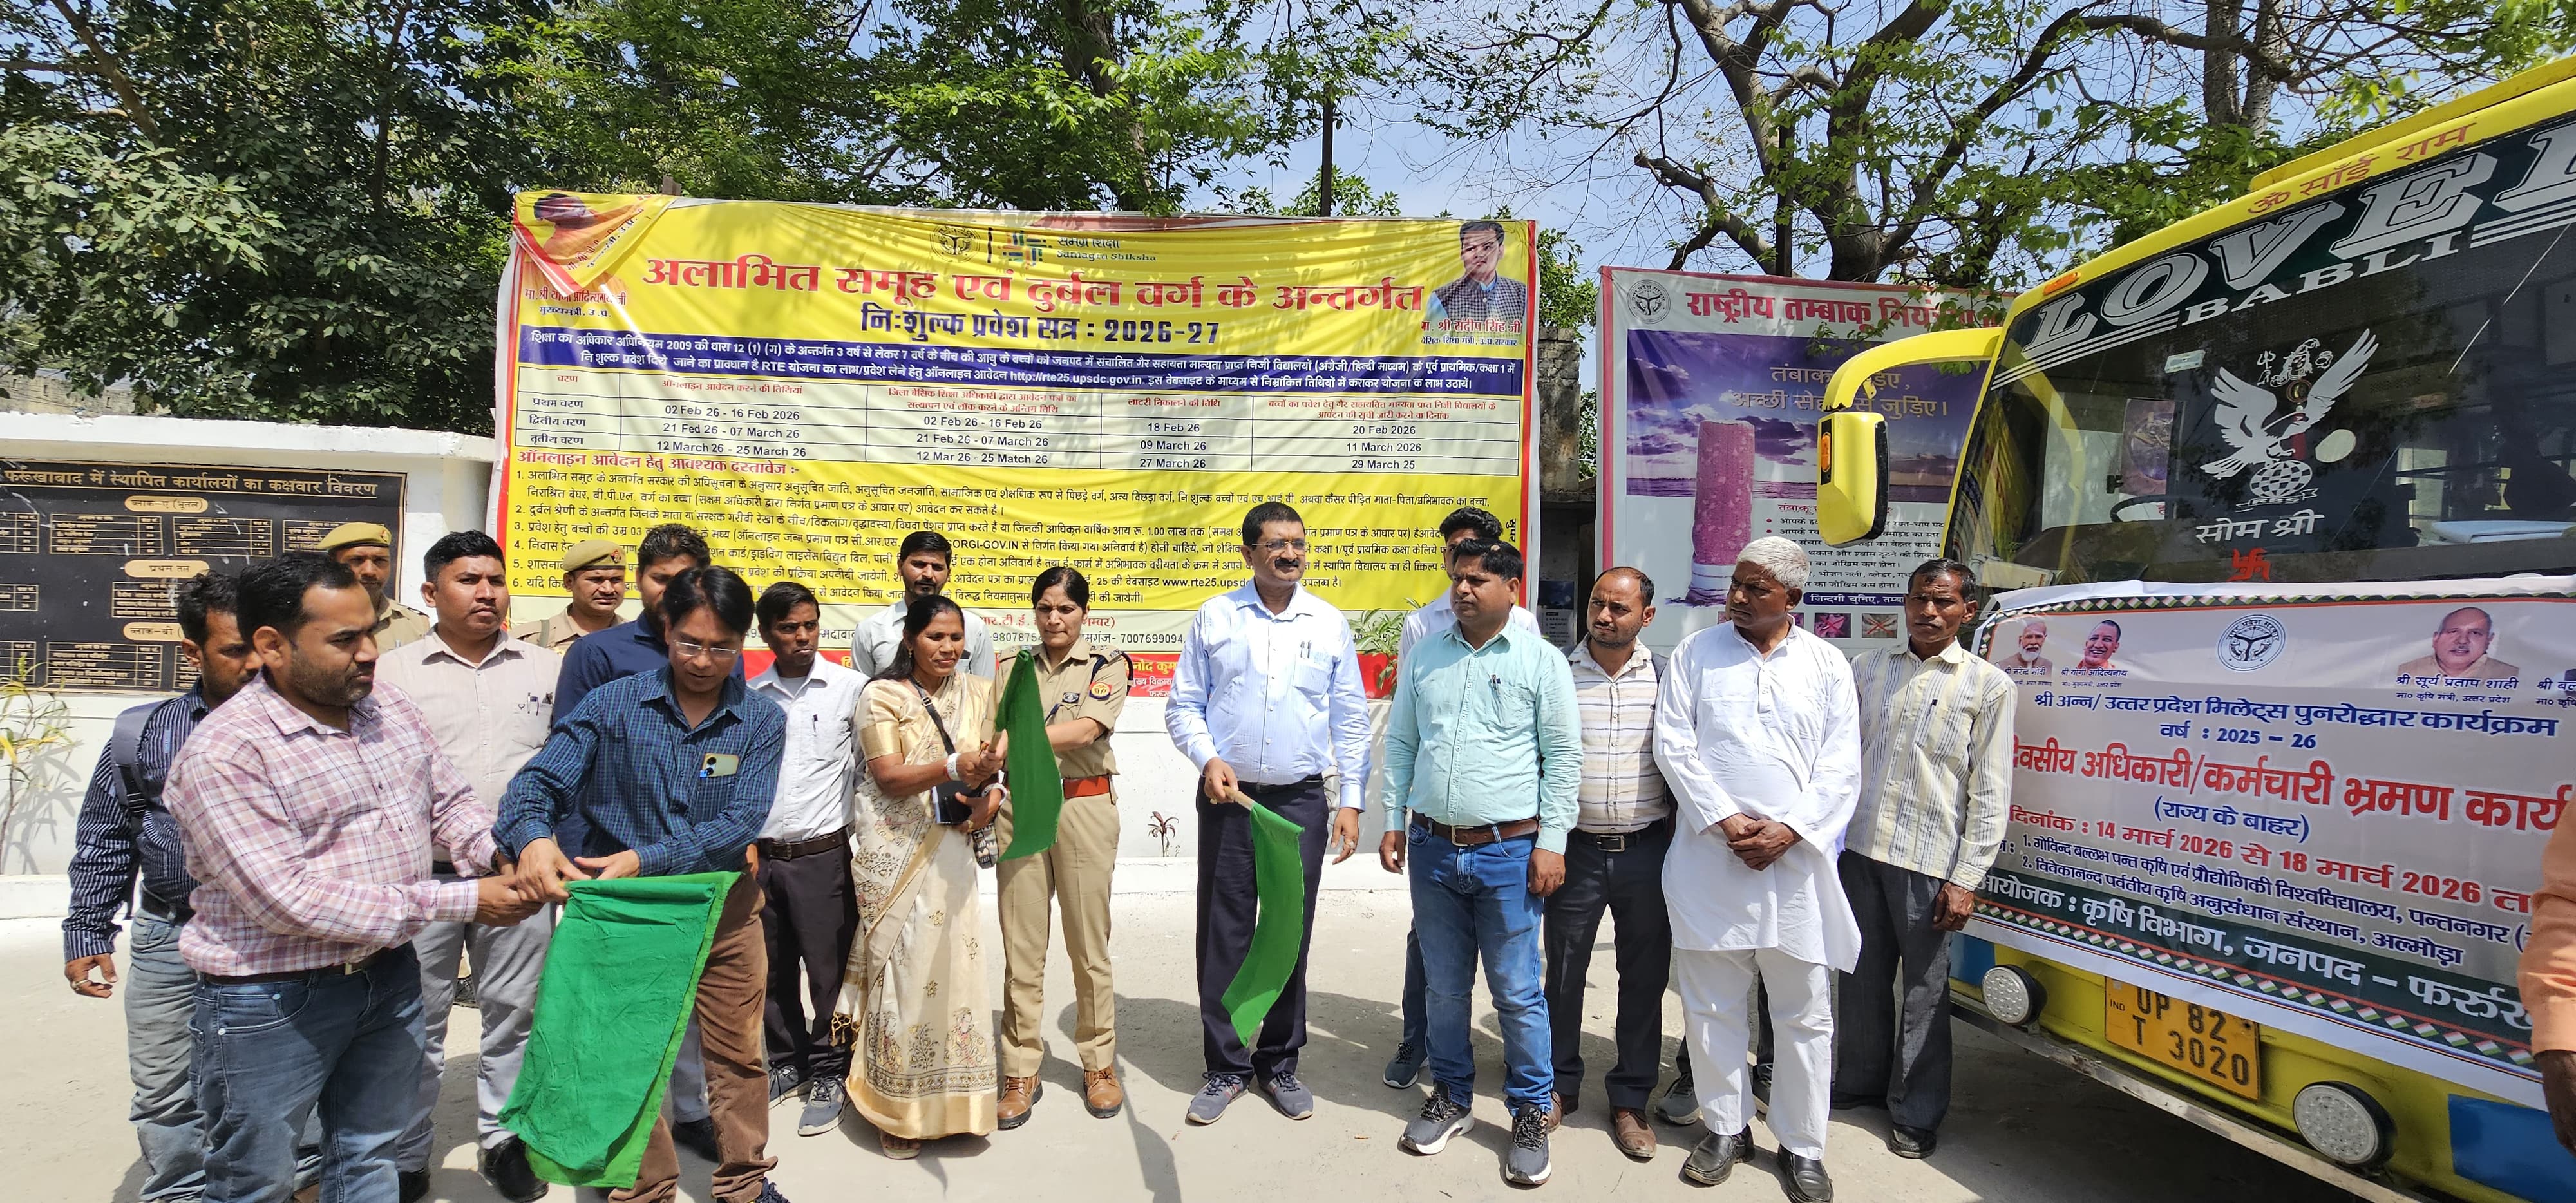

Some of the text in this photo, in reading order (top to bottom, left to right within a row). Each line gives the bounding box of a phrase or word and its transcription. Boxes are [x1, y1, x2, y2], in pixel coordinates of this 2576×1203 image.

[2396, 122, 2477, 160] राम
[1057, 251, 1156, 262] Samagra Shiksha
[643, 254, 1424, 312] अलाभित समूह एवं दुर्बल वर्ग के अन्तर्गत
[2183, 229, 2463, 326] BABLI
[1685, 288, 1776, 323] राष्ट्रीय
[972, 309, 1030, 339] प्रवेश
[1037, 317, 1080, 341] सत्र
[1104, 319, 1219, 344] 2026-27
[1438, 318, 1521, 334] श्री संदीप सिंह जी
[762, 359, 786, 372] RTE
[533, 398, 557, 407] प्रथम
[665, 405, 677, 414] 02
[681, 405, 702, 415] Feb
[706, 408, 719, 417] 26
[731, 409, 743, 418] 16
[748, 410, 768, 419] Feb
[773, 411, 799, 420] 2026
[1731, 389, 1788, 409] अच्छी
[1148, 422, 1200, 433] 18 Feb 26
[1352, 425, 1416, 435] 20 Feb 2026
[518, 450, 586, 466] ऑनलाइन
[592, 453, 641, 468] आवेदन
[646, 455, 663, 472] हेतु
[669, 459, 726, 471] आवश्यक
[730, 460, 786, 474] दस्तावेज
[89, 470, 105, 484] में
[110, 470, 166, 487] स्थापित
[172, 471, 238, 490] कार्यालयों
[243, 478, 262, 490] का
[327, 477, 378, 495] विवरण
[527, 469, 567, 481] अलाभित
[571, 473, 592, 484] समूह
[596, 471, 605, 483] के
[609, 473, 643, 485] अन्तर्गत
[647, 477, 674, 486] सरकार
[677, 475, 690, 486] की
[1113, 526, 1130, 535] आय
[1148, 527, 1164, 536] 1.00
[1168, 527, 1187, 536] लाख
[2196, 509, 2325, 544] सोम श्री
[1810, 594, 1844, 603] जिन्दगी
[2071, 667, 2086, 676] योगी
[2395, 674, 2409, 685] श्री
[2415, 674, 2440, 689] सूर्य
[2485, 676, 2519, 690] शाही
[2035, 690, 2054, 706] श्री
[2105, 696, 2150, 710] उत्तर
[2154, 695, 2200, 714] प्रदेश
[2205, 696, 2289, 723] मिलेट्स
[2295, 703, 2418, 727] पुनरोद्धार
[2421, 710, 2559, 737] कार्यक्रम
[2160, 720, 2191, 738] वर्ष
[2217, 728, 2260, 743] 2025
[2291, 734, 2316, 749] 26
[2082, 742, 2335, 805] अधिकारी/कर्मचारी
[2344, 776, 2454, 821] भ्रमण
[2155, 795, 2310, 844] (राज्य के बाहर)
[2009, 805, 2076, 832] दिनांक
[2096, 820, 2115, 838] 14
[2122, 826, 2176, 849] मार्च
[2181, 833, 2233, 859] 2026
[2240, 843, 2272, 867] से
[2280, 851, 2307, 873] 18
[2316, 858, 2394, 888] मार्च
[2402, 872, 2480, 903] 2026
[2023, 833, 2510, 943] 1. गोविन्द बल्लभ पन्त कृषि एवं प्रौद्योगिकी विश्वविद्यालय, पन्तनगर
[2022, 855, 2463, 967] 2. विवेकानन्द पर्वतीय कृषि अनुसंधान संस्थान, अल्मोड़ा
[2082, 897, 2133, 929] कृषि
[2138, 905, 2233, 956] विभाग,
[2244, 936, 2365, 986] जनपद
[2110, 999, 2125, 1011] IND
[2137, 987, 2227, 1044] UP 82
[2132, 1014, 2249, 1086] T 3020
